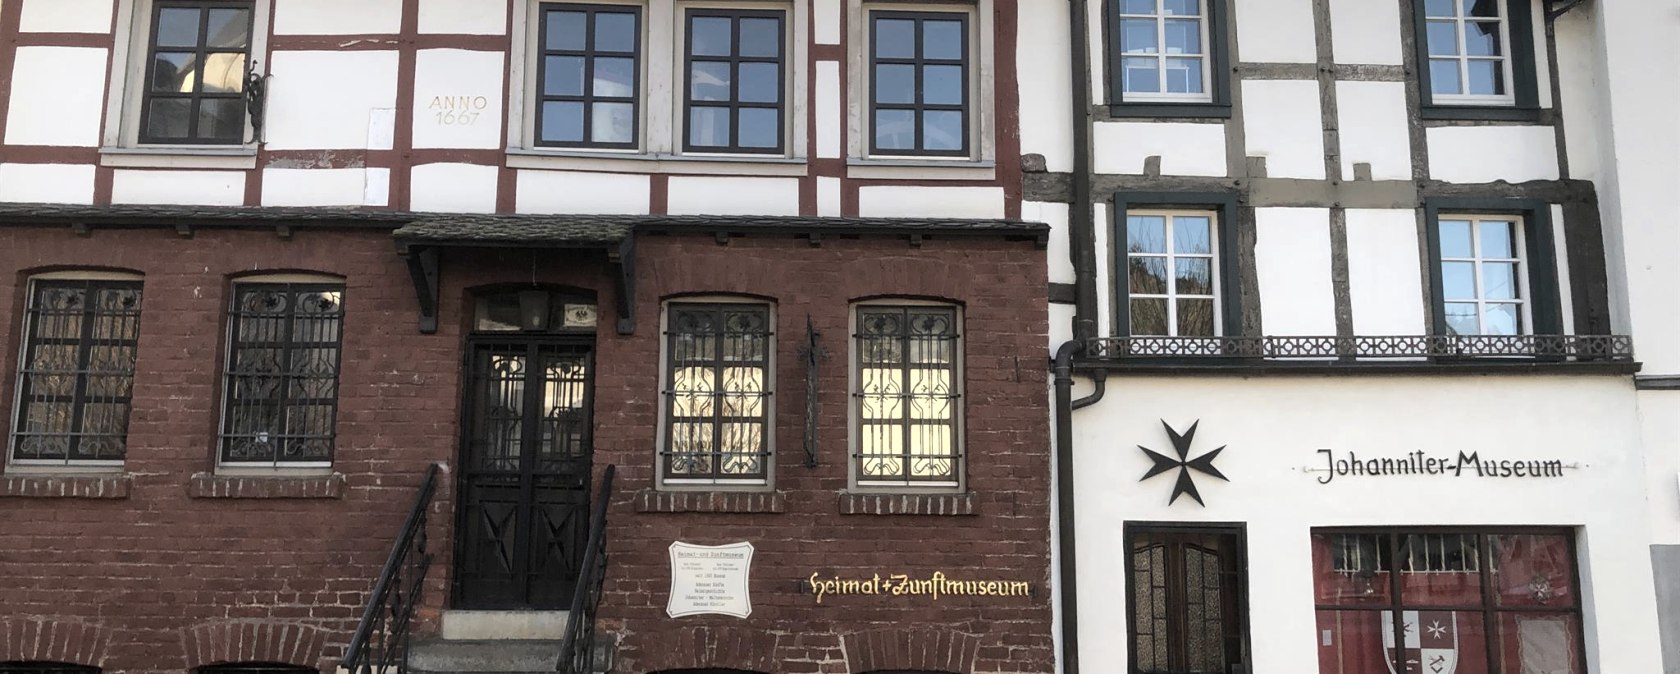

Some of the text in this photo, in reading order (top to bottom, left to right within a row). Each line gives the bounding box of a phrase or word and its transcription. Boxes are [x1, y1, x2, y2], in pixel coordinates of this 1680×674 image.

[429, 95, 487, 110] ANNO
[435, 110, 480, 125] 1667
[1316, 448, 1564, 485] Johanniter-Museum
